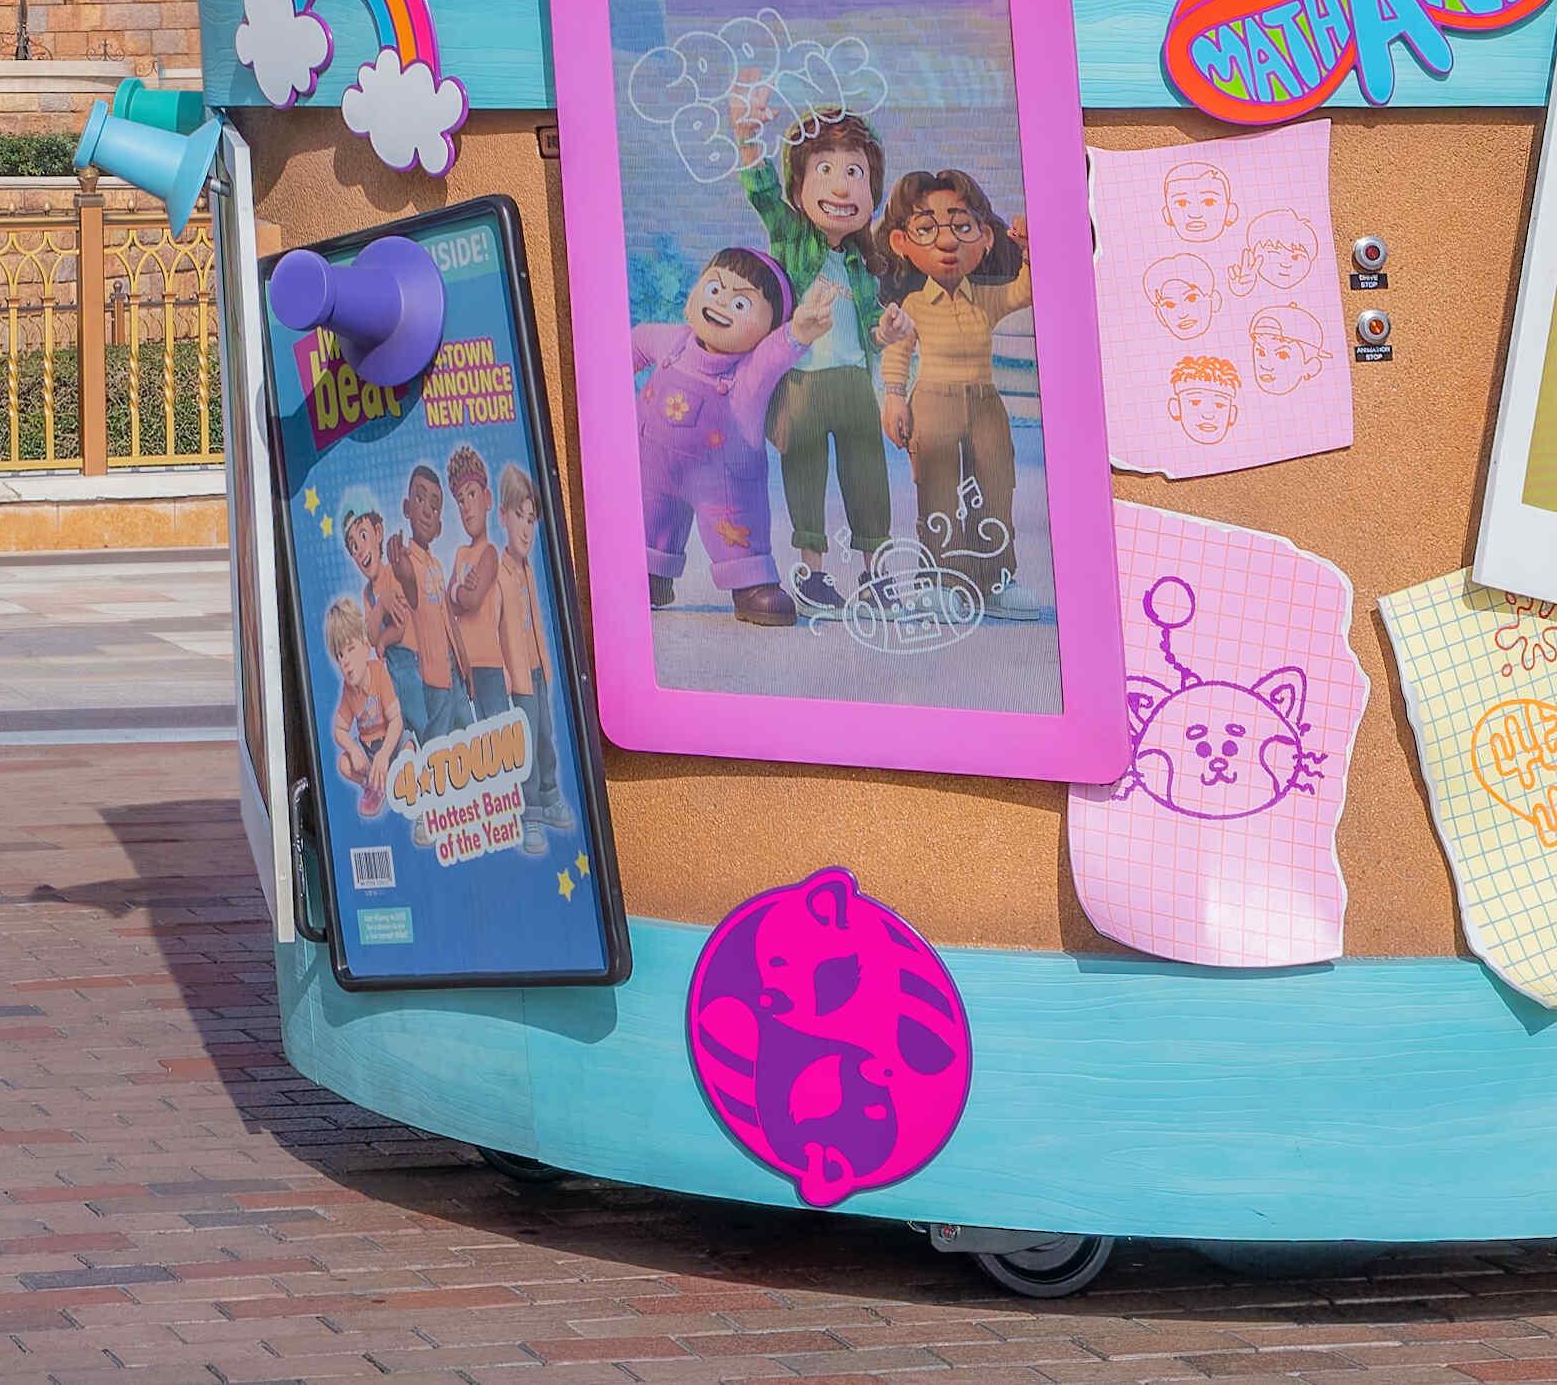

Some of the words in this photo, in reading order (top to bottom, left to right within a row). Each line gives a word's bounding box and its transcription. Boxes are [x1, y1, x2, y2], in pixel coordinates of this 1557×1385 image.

[628, 7, 825, 124] COOL
[671, 36, 888, 183] BEANS
[425, 232, 489, 271] SIDE!
[1365, 353, 1383, 361] STOP
[422, 365, 513, 399] ANNOUNCE
[426, 398, 464, 427] NEW
[465, 393, 515, 423] TOUR!
[425, 799, 482, 836] Hottest
[482, 781, 522, 818] Band
[439, 833, 457, 860] of
[456, 829, 482, 856] the
[484, 815, 521, 848] Year!
